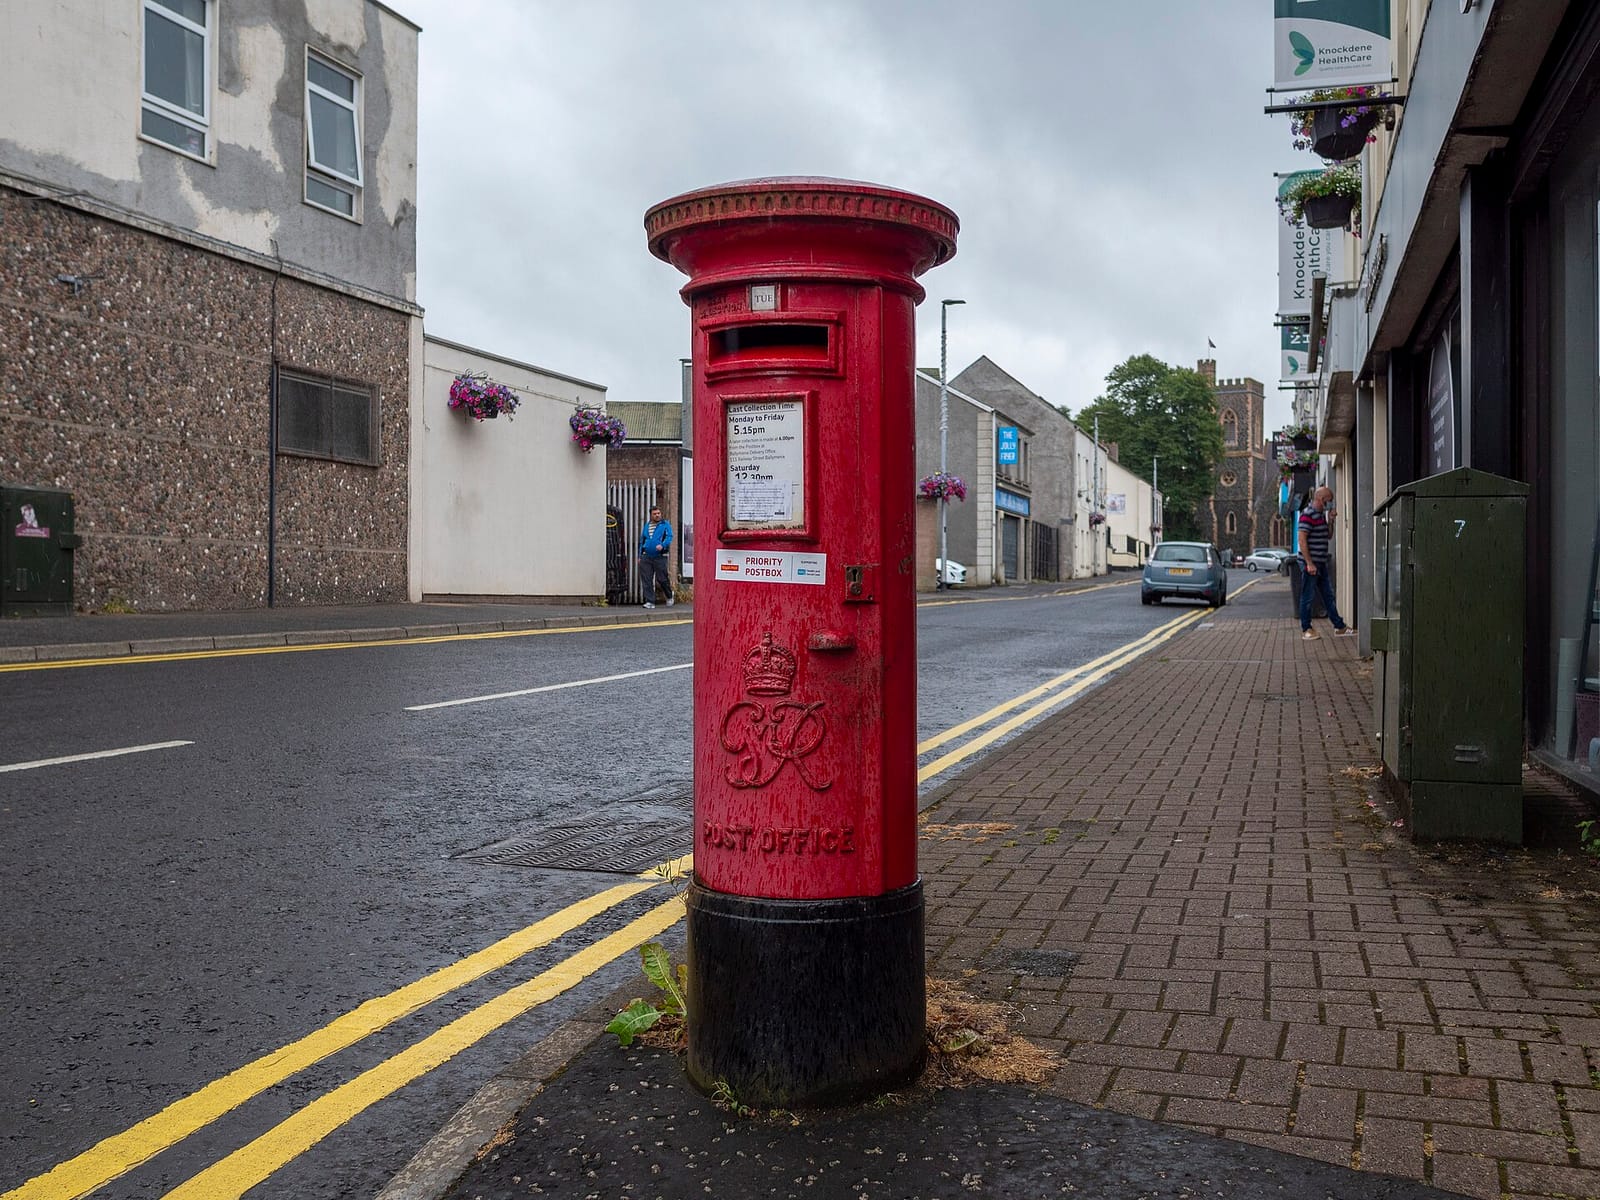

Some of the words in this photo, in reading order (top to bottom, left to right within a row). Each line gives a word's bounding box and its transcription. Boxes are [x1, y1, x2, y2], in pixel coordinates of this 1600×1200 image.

[1318, 45, 1372, 55] Knockdene
[1318, 55, 1371, 64] HealthCare
[1293, 219, 1305, 299] Knockden
[754, 294, 774, 303] TUE
[743, 404, 776, 412] Collection
[763, 413, 785, 421] Friday
[733, 424, 766, 435] 5.15pm
[1003, 431, 1013, 439] THE
[730, 464, 760, 472] Saturday
[1454, 519, 1466, 538] 7
[745, 557, 783, 566] PRIORITY
[745, 568, 782, 577] POSTBOX
[702, 819, 752, 852] POST
[760, 825, 855, 854] OFFICE
